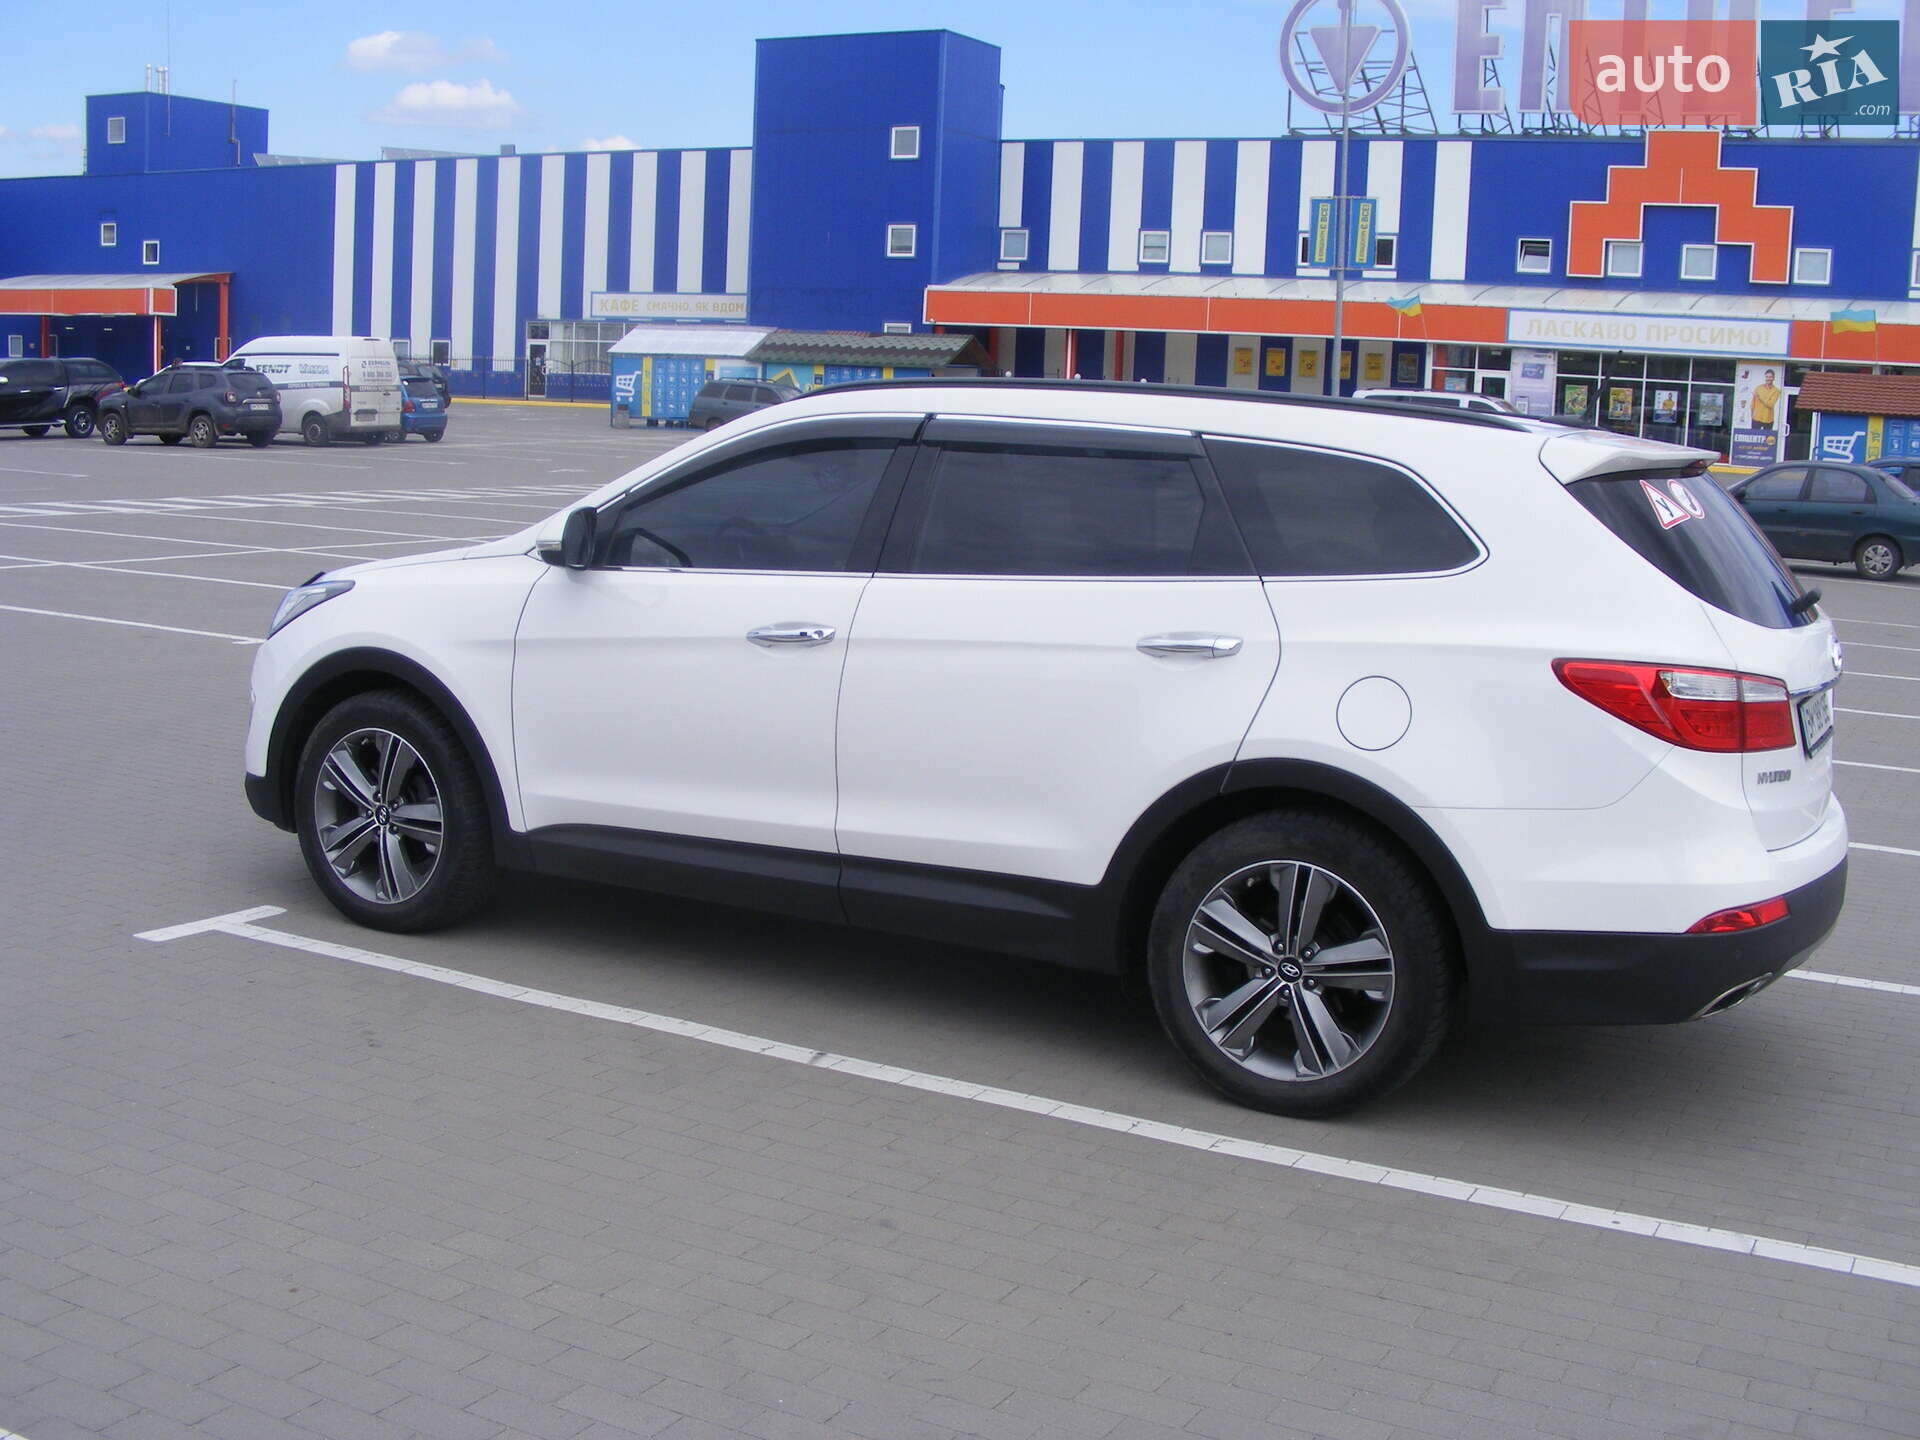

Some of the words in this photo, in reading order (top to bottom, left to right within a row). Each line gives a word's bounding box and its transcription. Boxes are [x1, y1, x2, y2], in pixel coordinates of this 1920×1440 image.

[599, 299, 639, 312] КАФЕ
[712, 302, 747, 314] ВДОМ
[1526, 319, 1638, 341] ЛАСКАВО
[1645, 325, 1772, 347] ПРОСИМО!
[255, 364, 292, 375] FENDT
